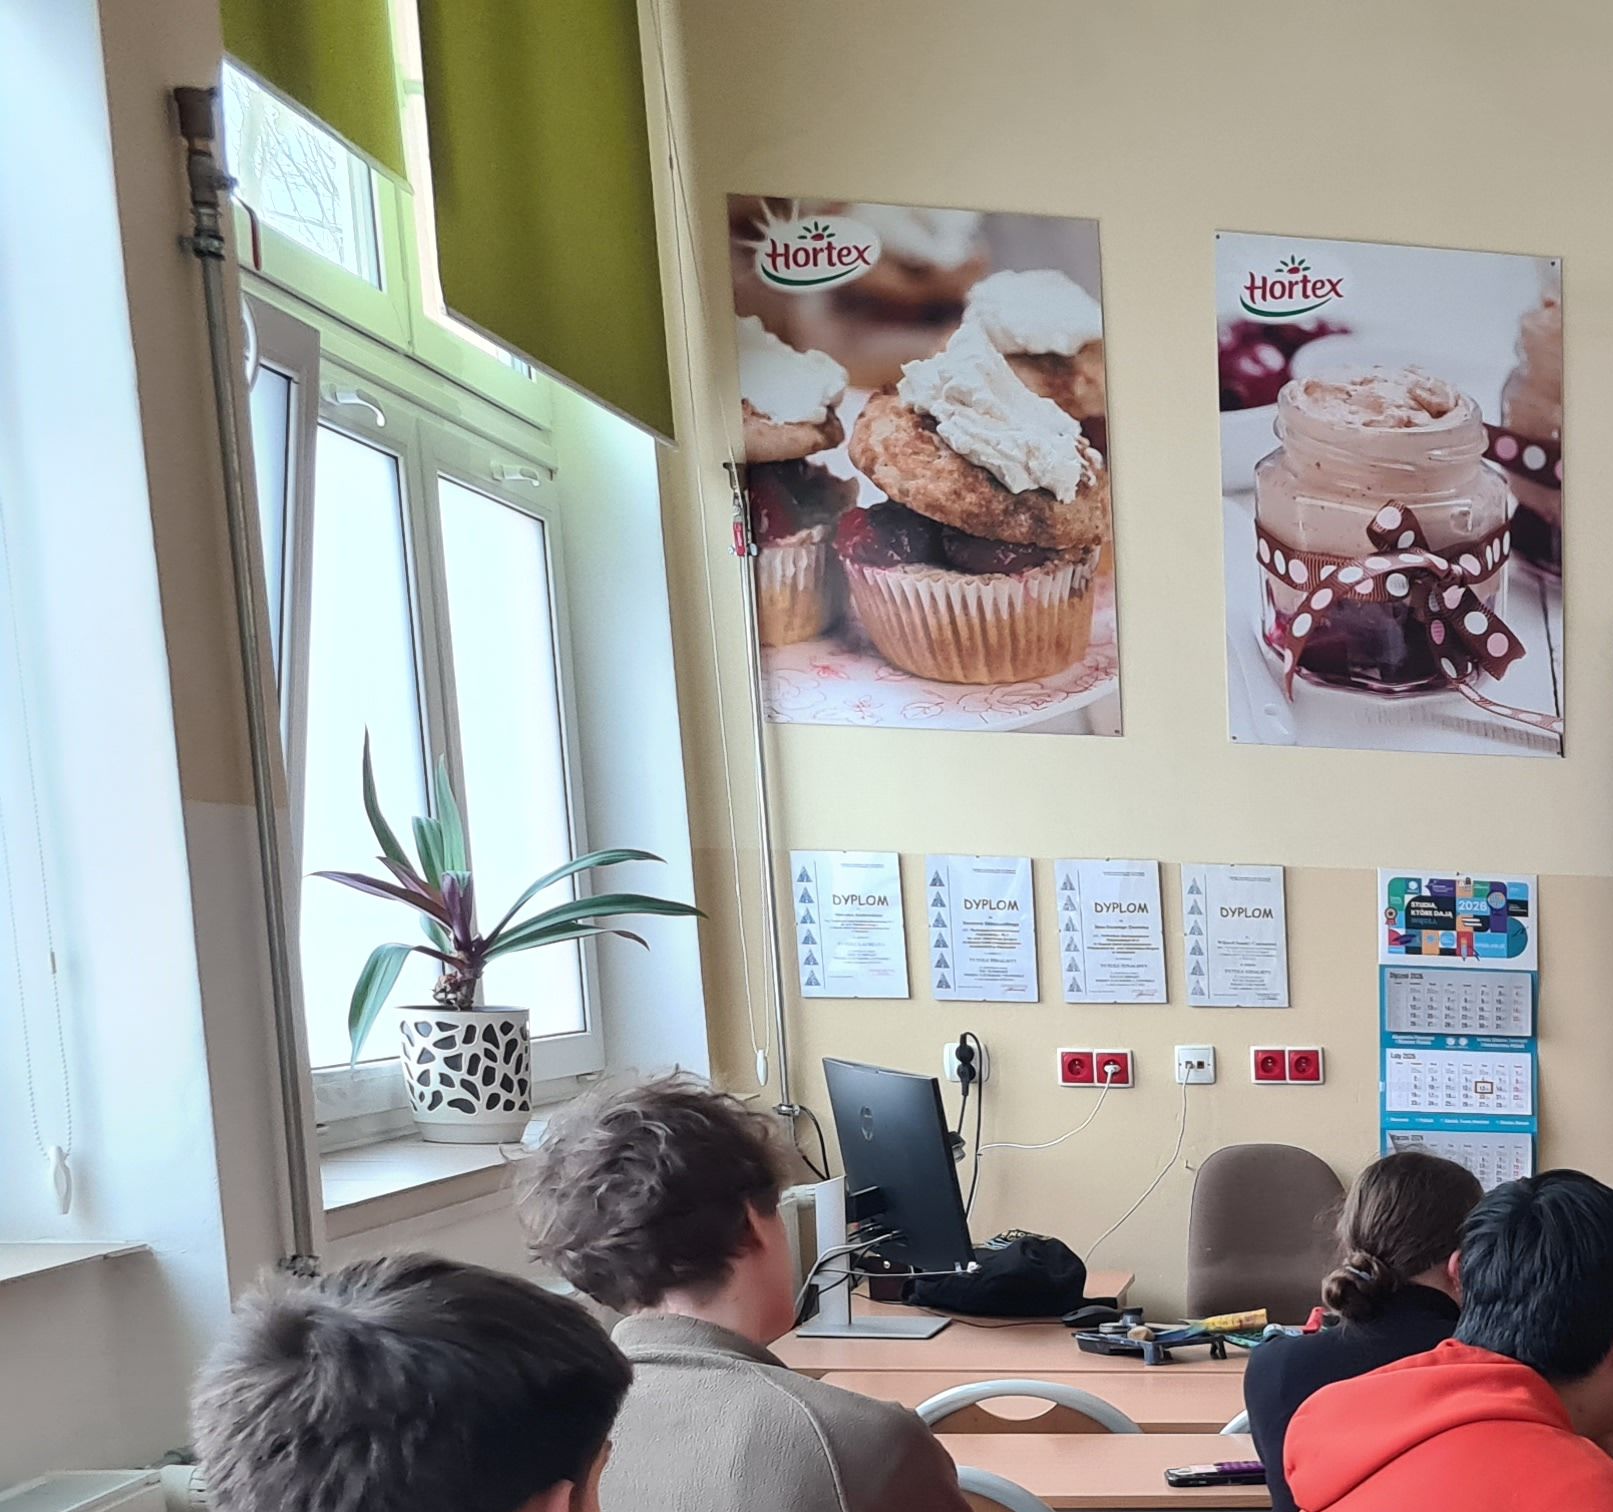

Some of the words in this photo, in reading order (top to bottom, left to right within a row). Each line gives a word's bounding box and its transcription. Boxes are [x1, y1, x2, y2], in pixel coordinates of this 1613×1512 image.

[764, 239, 872, 270] Hortex
[1243, 270, 1344, 304] Hortex
[832, 895, 889, 907] DYPLOM
[964, 899, 1019, 911] DYPLOM
[1458, 901, 1487, 911] 2026
[1094, 902, 1149, 914] DYPLOM
[1220, 906, 1274, 919] DYPLOM
